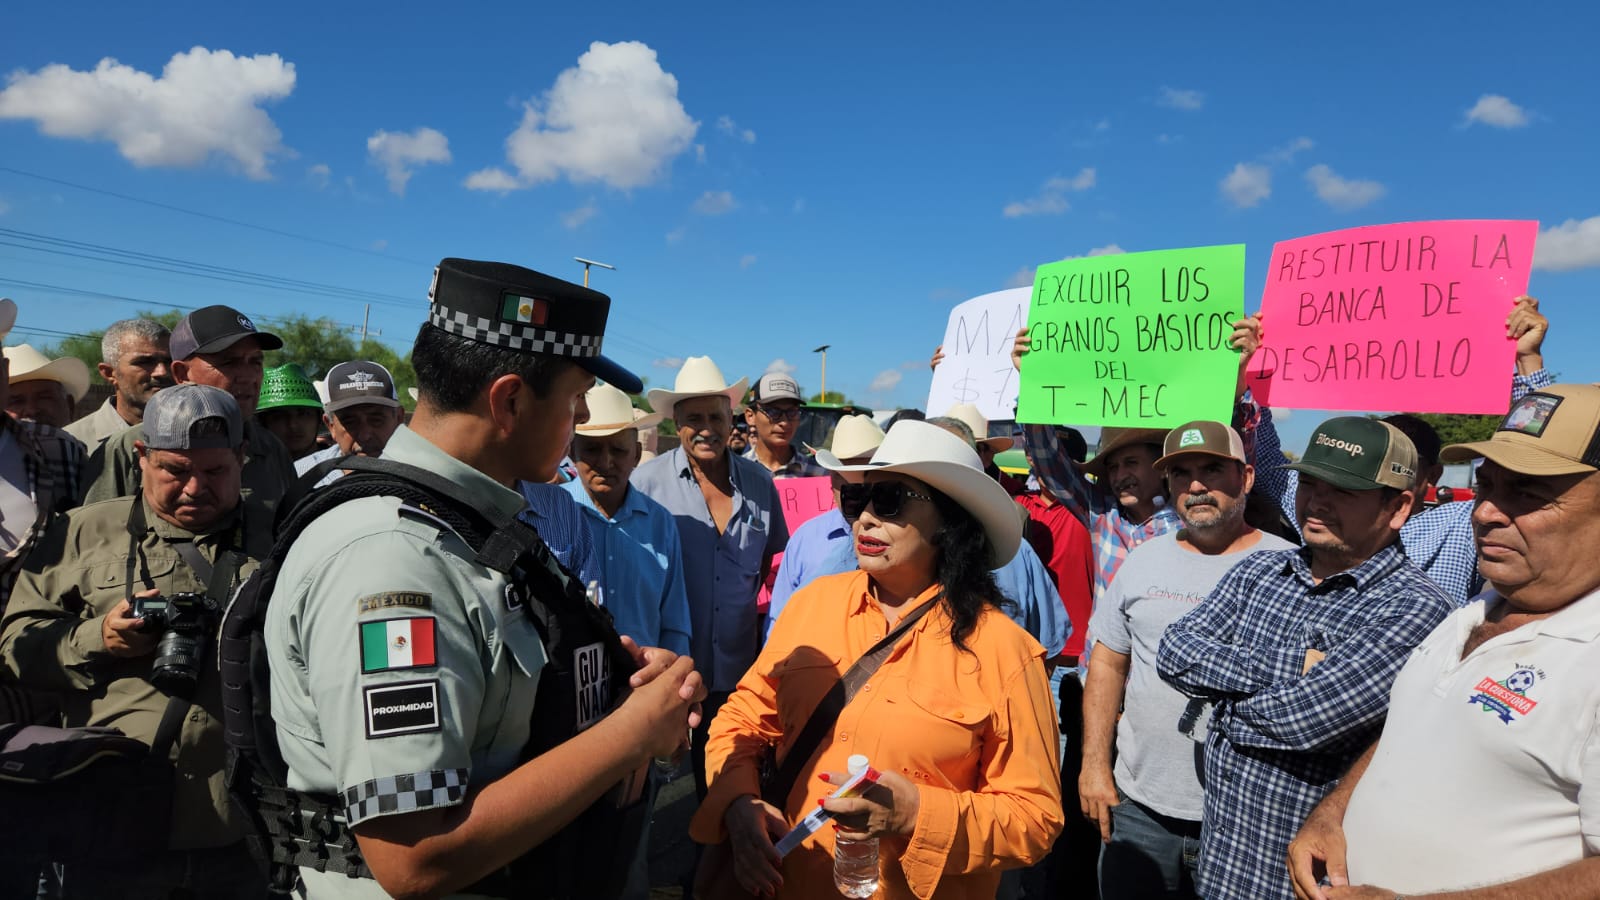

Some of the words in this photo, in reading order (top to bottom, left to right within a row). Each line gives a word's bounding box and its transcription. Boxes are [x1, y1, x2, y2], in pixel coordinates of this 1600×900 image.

[1278, 235, 1437, 282] RESTITUIR
[1471, 233, 1512, 269] LA
[1037, 268, 1131, 307] EXCLUIR
[1161, 266, 1209, 303] LOS
[1297, 285, 1387, 327] BANCA
[1420, 281, 1462, 318] DE
[1030, 316, 1120, 353] GRANOS
[1136, 311, 1237, 353] BASICOS
[1094, 360, 1136, 382] DEL
[1255, 337, 1471, 383] DESARROLLO
[815, 486, 835, 512] L
[1146, 585, 1184, 602] Calvin
[372, 701, 434, 716] PROXIMIDAD
